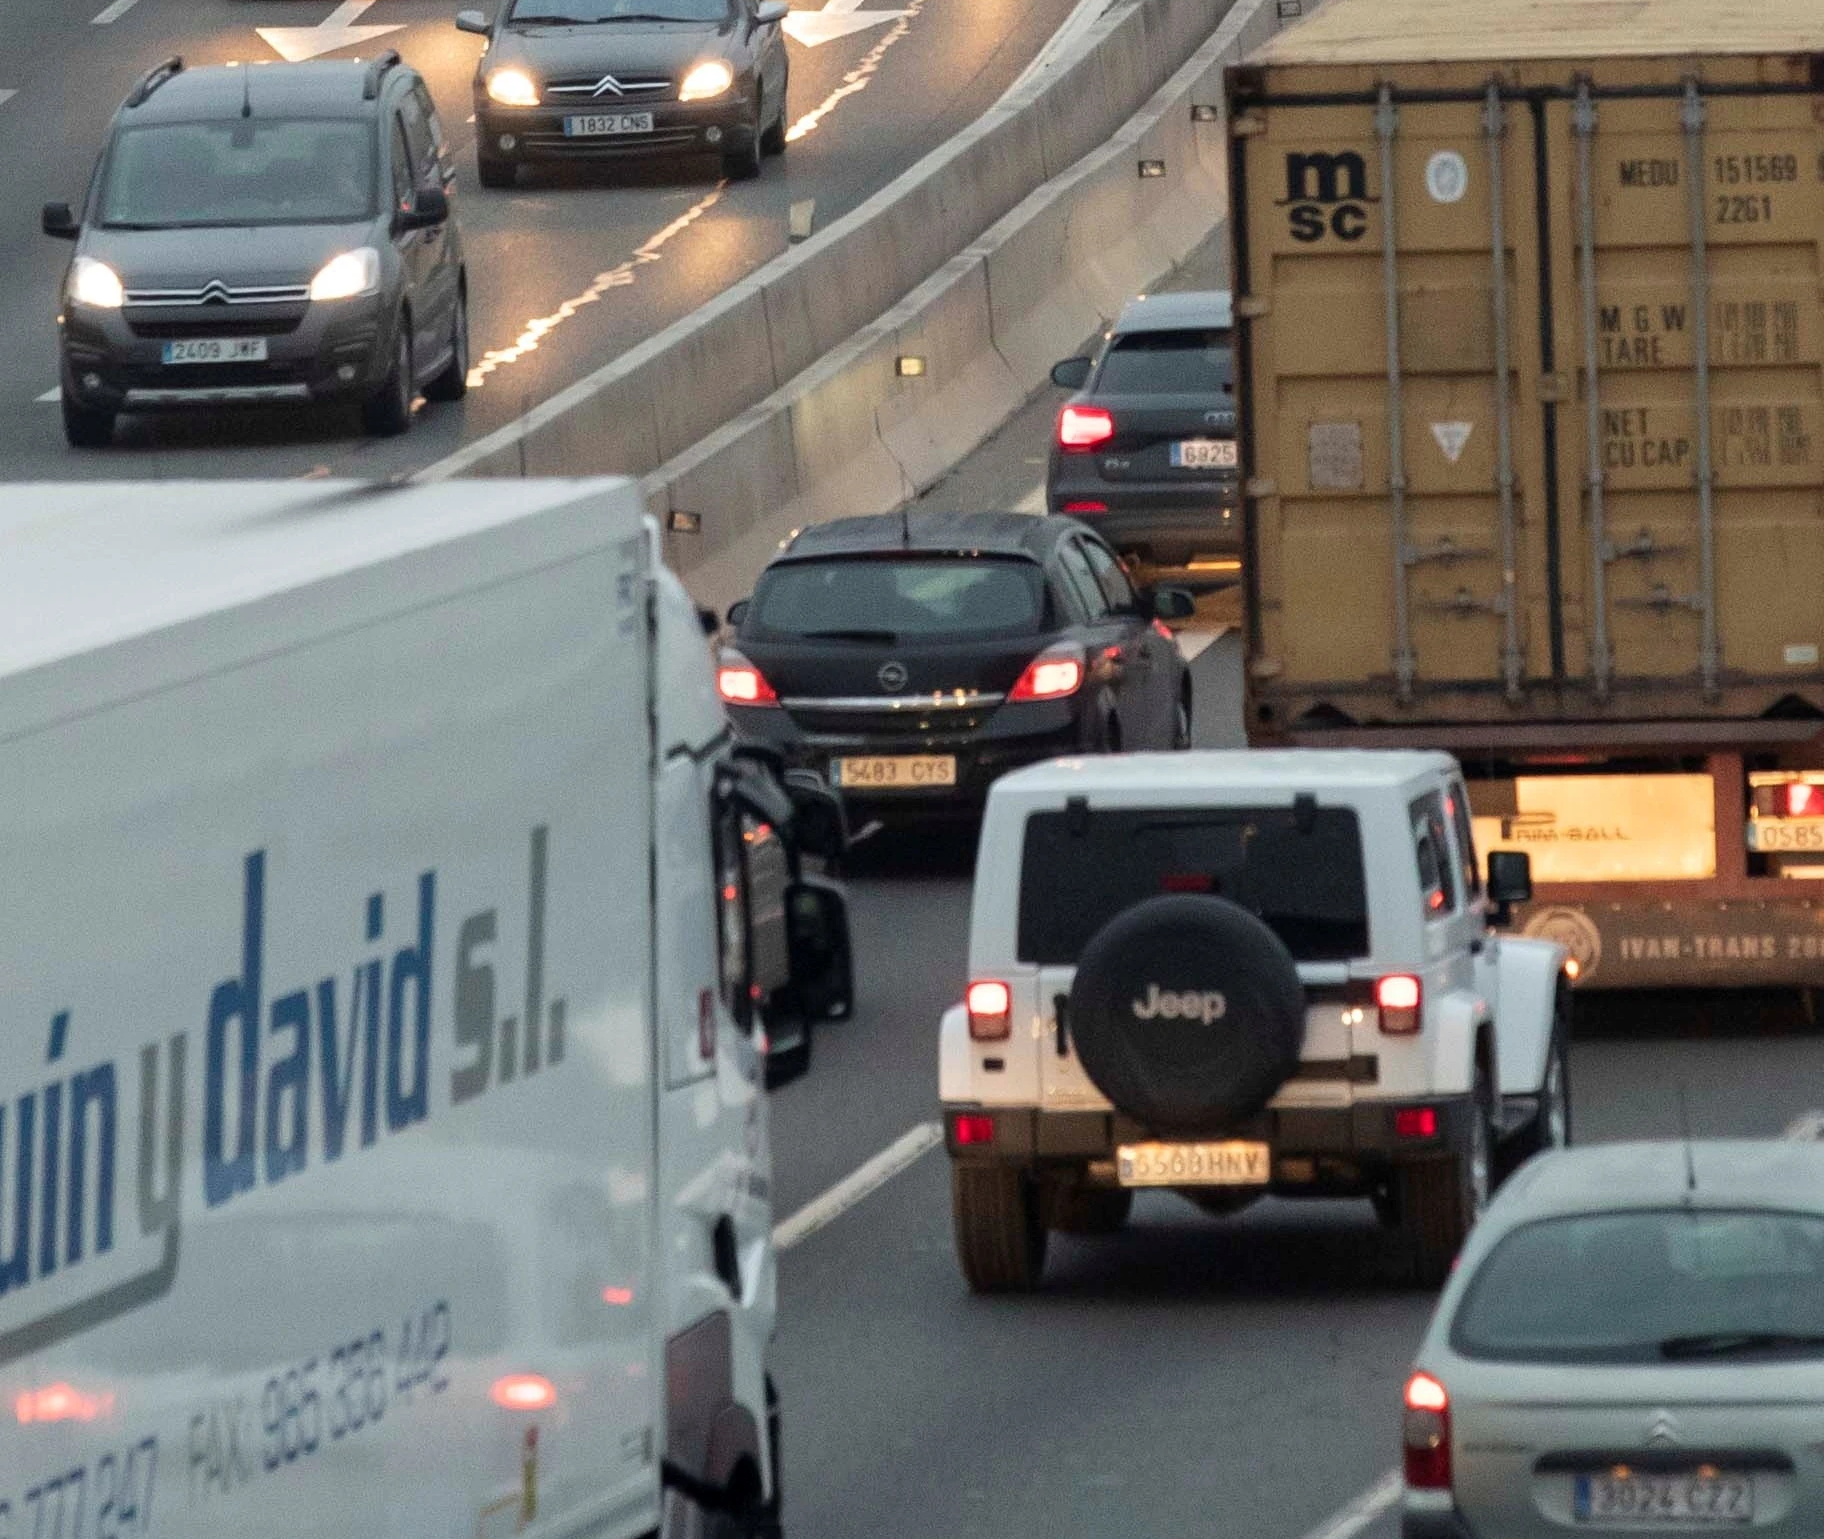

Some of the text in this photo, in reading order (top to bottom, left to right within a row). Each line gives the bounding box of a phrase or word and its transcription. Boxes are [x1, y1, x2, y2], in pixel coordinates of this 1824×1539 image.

[579, 118, 616, 134] 1832
[1620, 159, 1679, 187] MEDU
[1602, 335, 1661, 363] TARE
[1603, 406, 1649, 437] NET
[846, 760, 950, 782] 5483 CYS
[200, 849, 437, 1208] david
[450, 825, 567, 1107] s.l.
[1133, 982, 1227, 1026] Jeep
